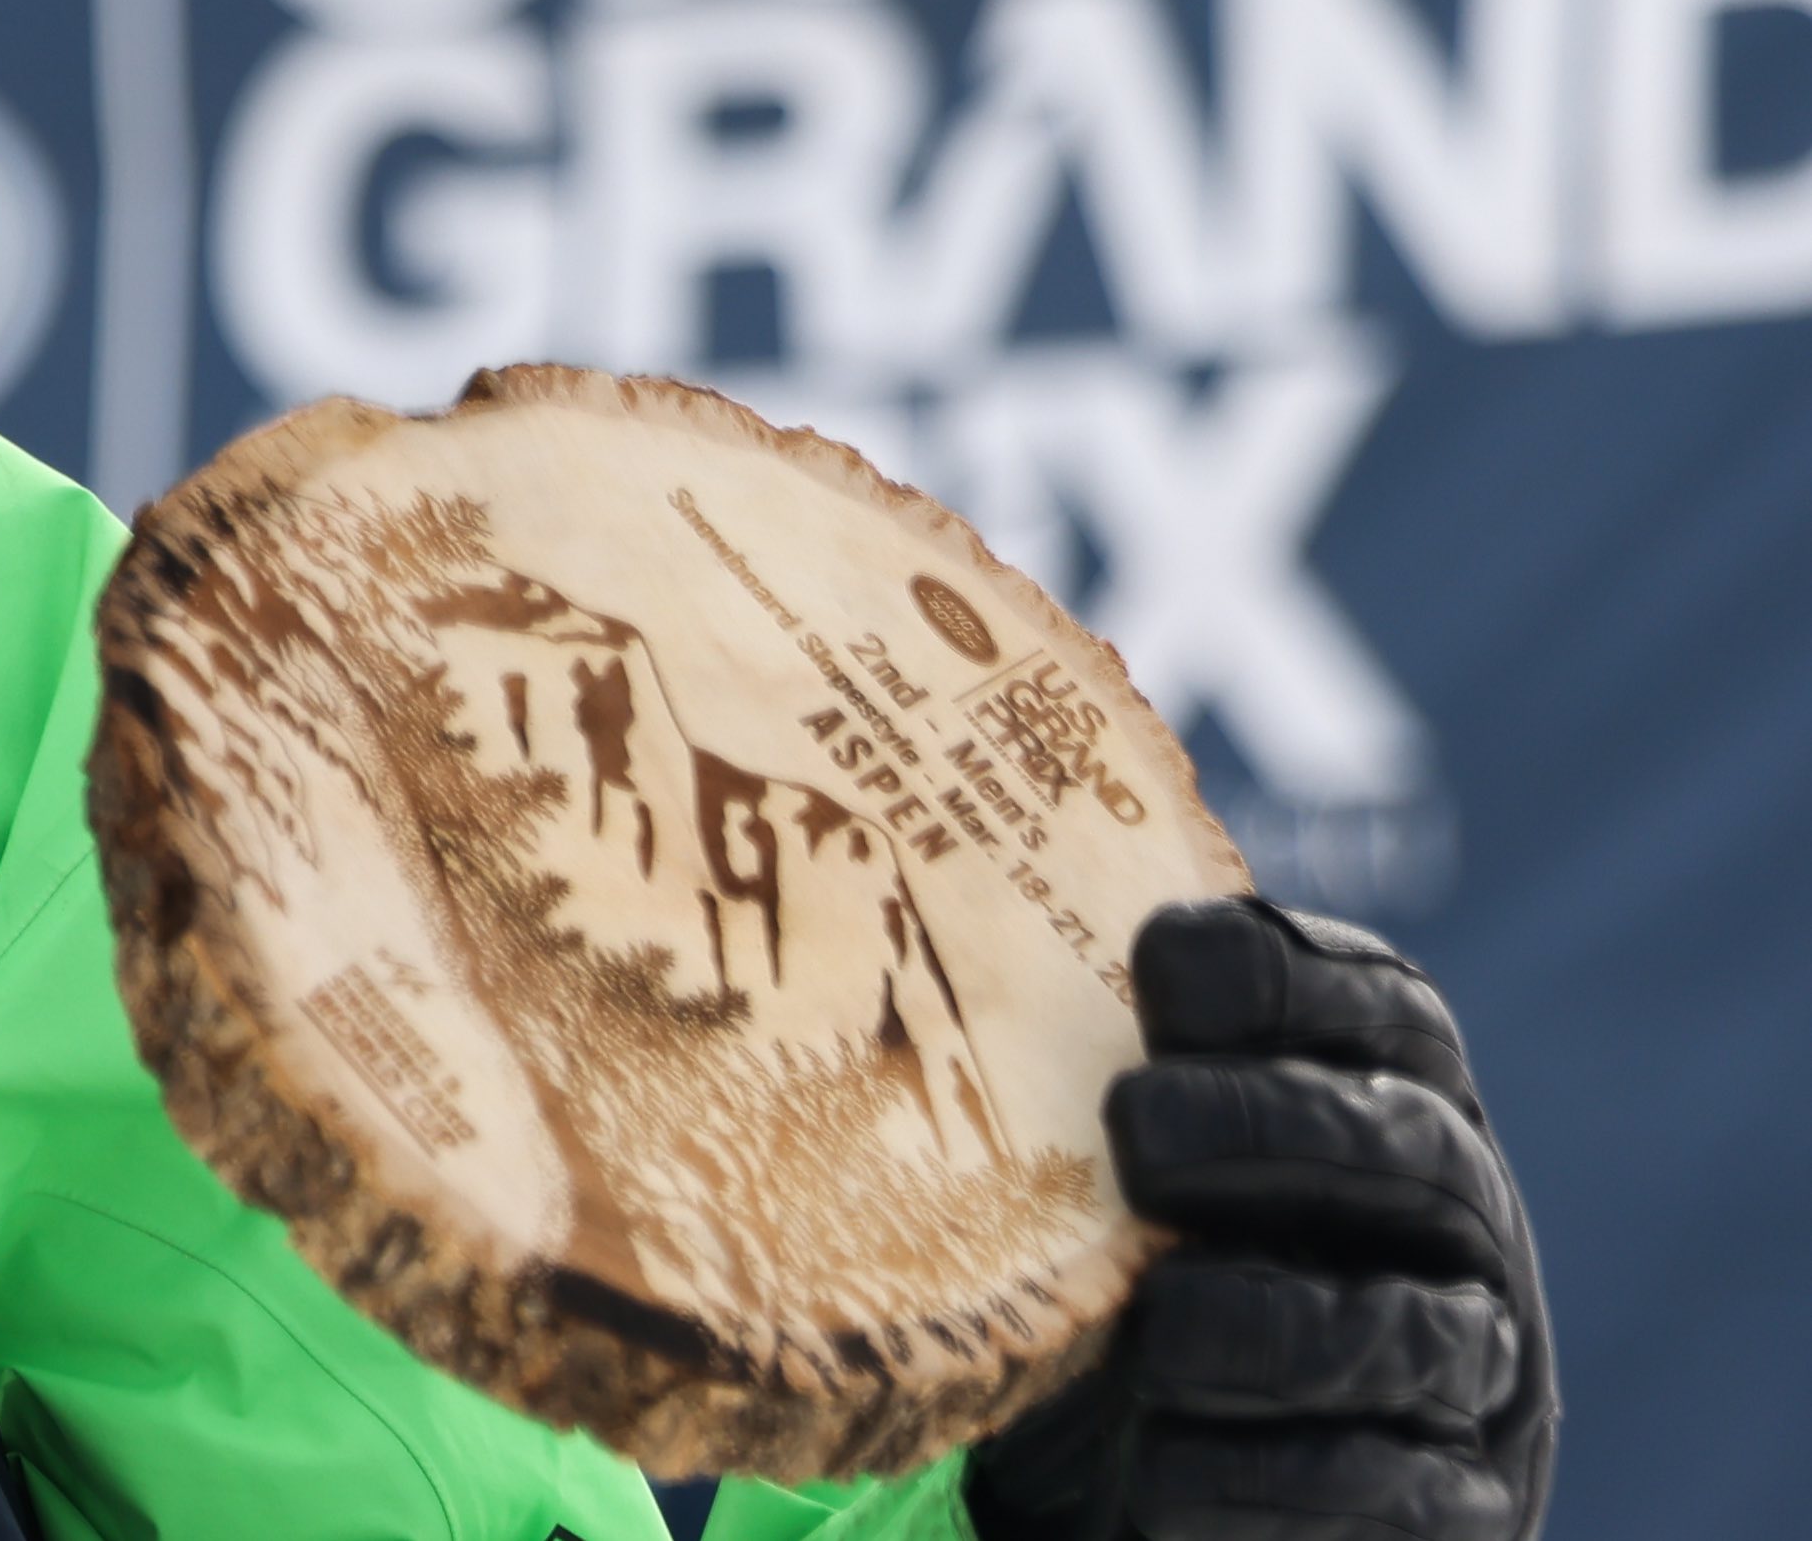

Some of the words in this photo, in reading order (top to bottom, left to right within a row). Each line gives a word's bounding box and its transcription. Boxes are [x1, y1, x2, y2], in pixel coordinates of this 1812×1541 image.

[667, 487, 803, 630] Snowboard
[796, 632, 921, 767] Slopestyle
[936, 786, 1001, 862] Mar.
[844, 632, 931, 711] 2nd
[943, 738, 1048, 852] Men's
[973, 693, 1084, 807] PRIX
[1033, 661, 1108, 747] U.S.
[798, 706, 960, 863] ASPEN
[1004, 679, 1147, 826] GRAND
